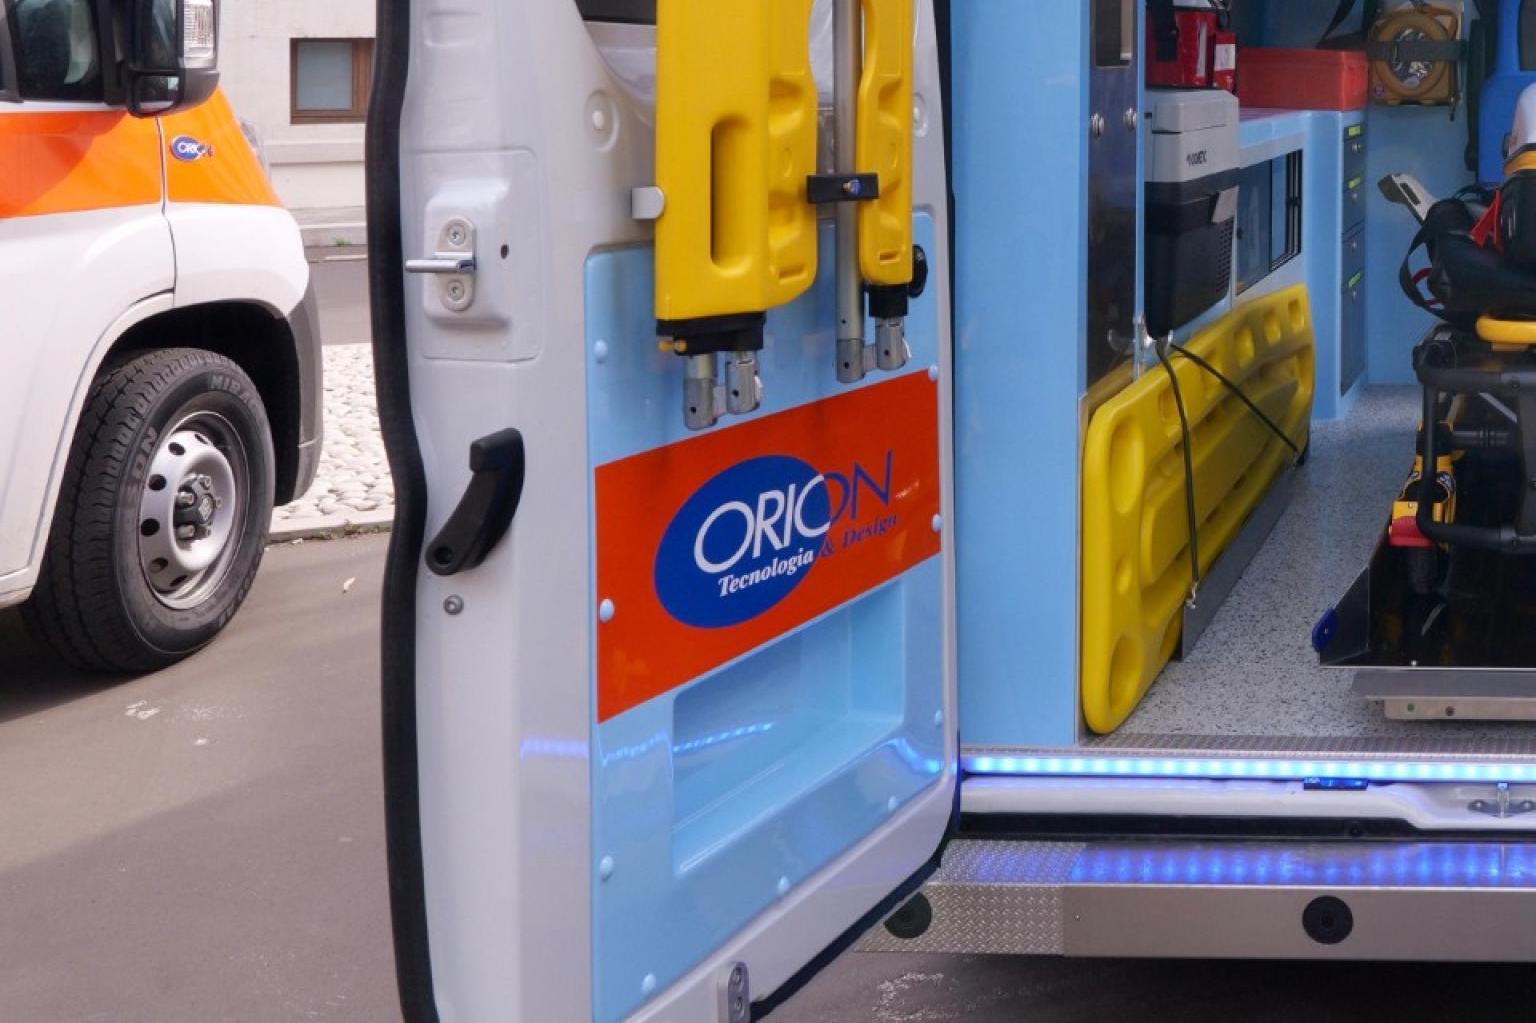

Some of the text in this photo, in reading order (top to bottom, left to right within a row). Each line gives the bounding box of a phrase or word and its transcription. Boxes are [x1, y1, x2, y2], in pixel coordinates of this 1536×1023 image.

[693, 449, 893, 573] ORION
[717, 516, 898, 598] Tecnologia & Design
